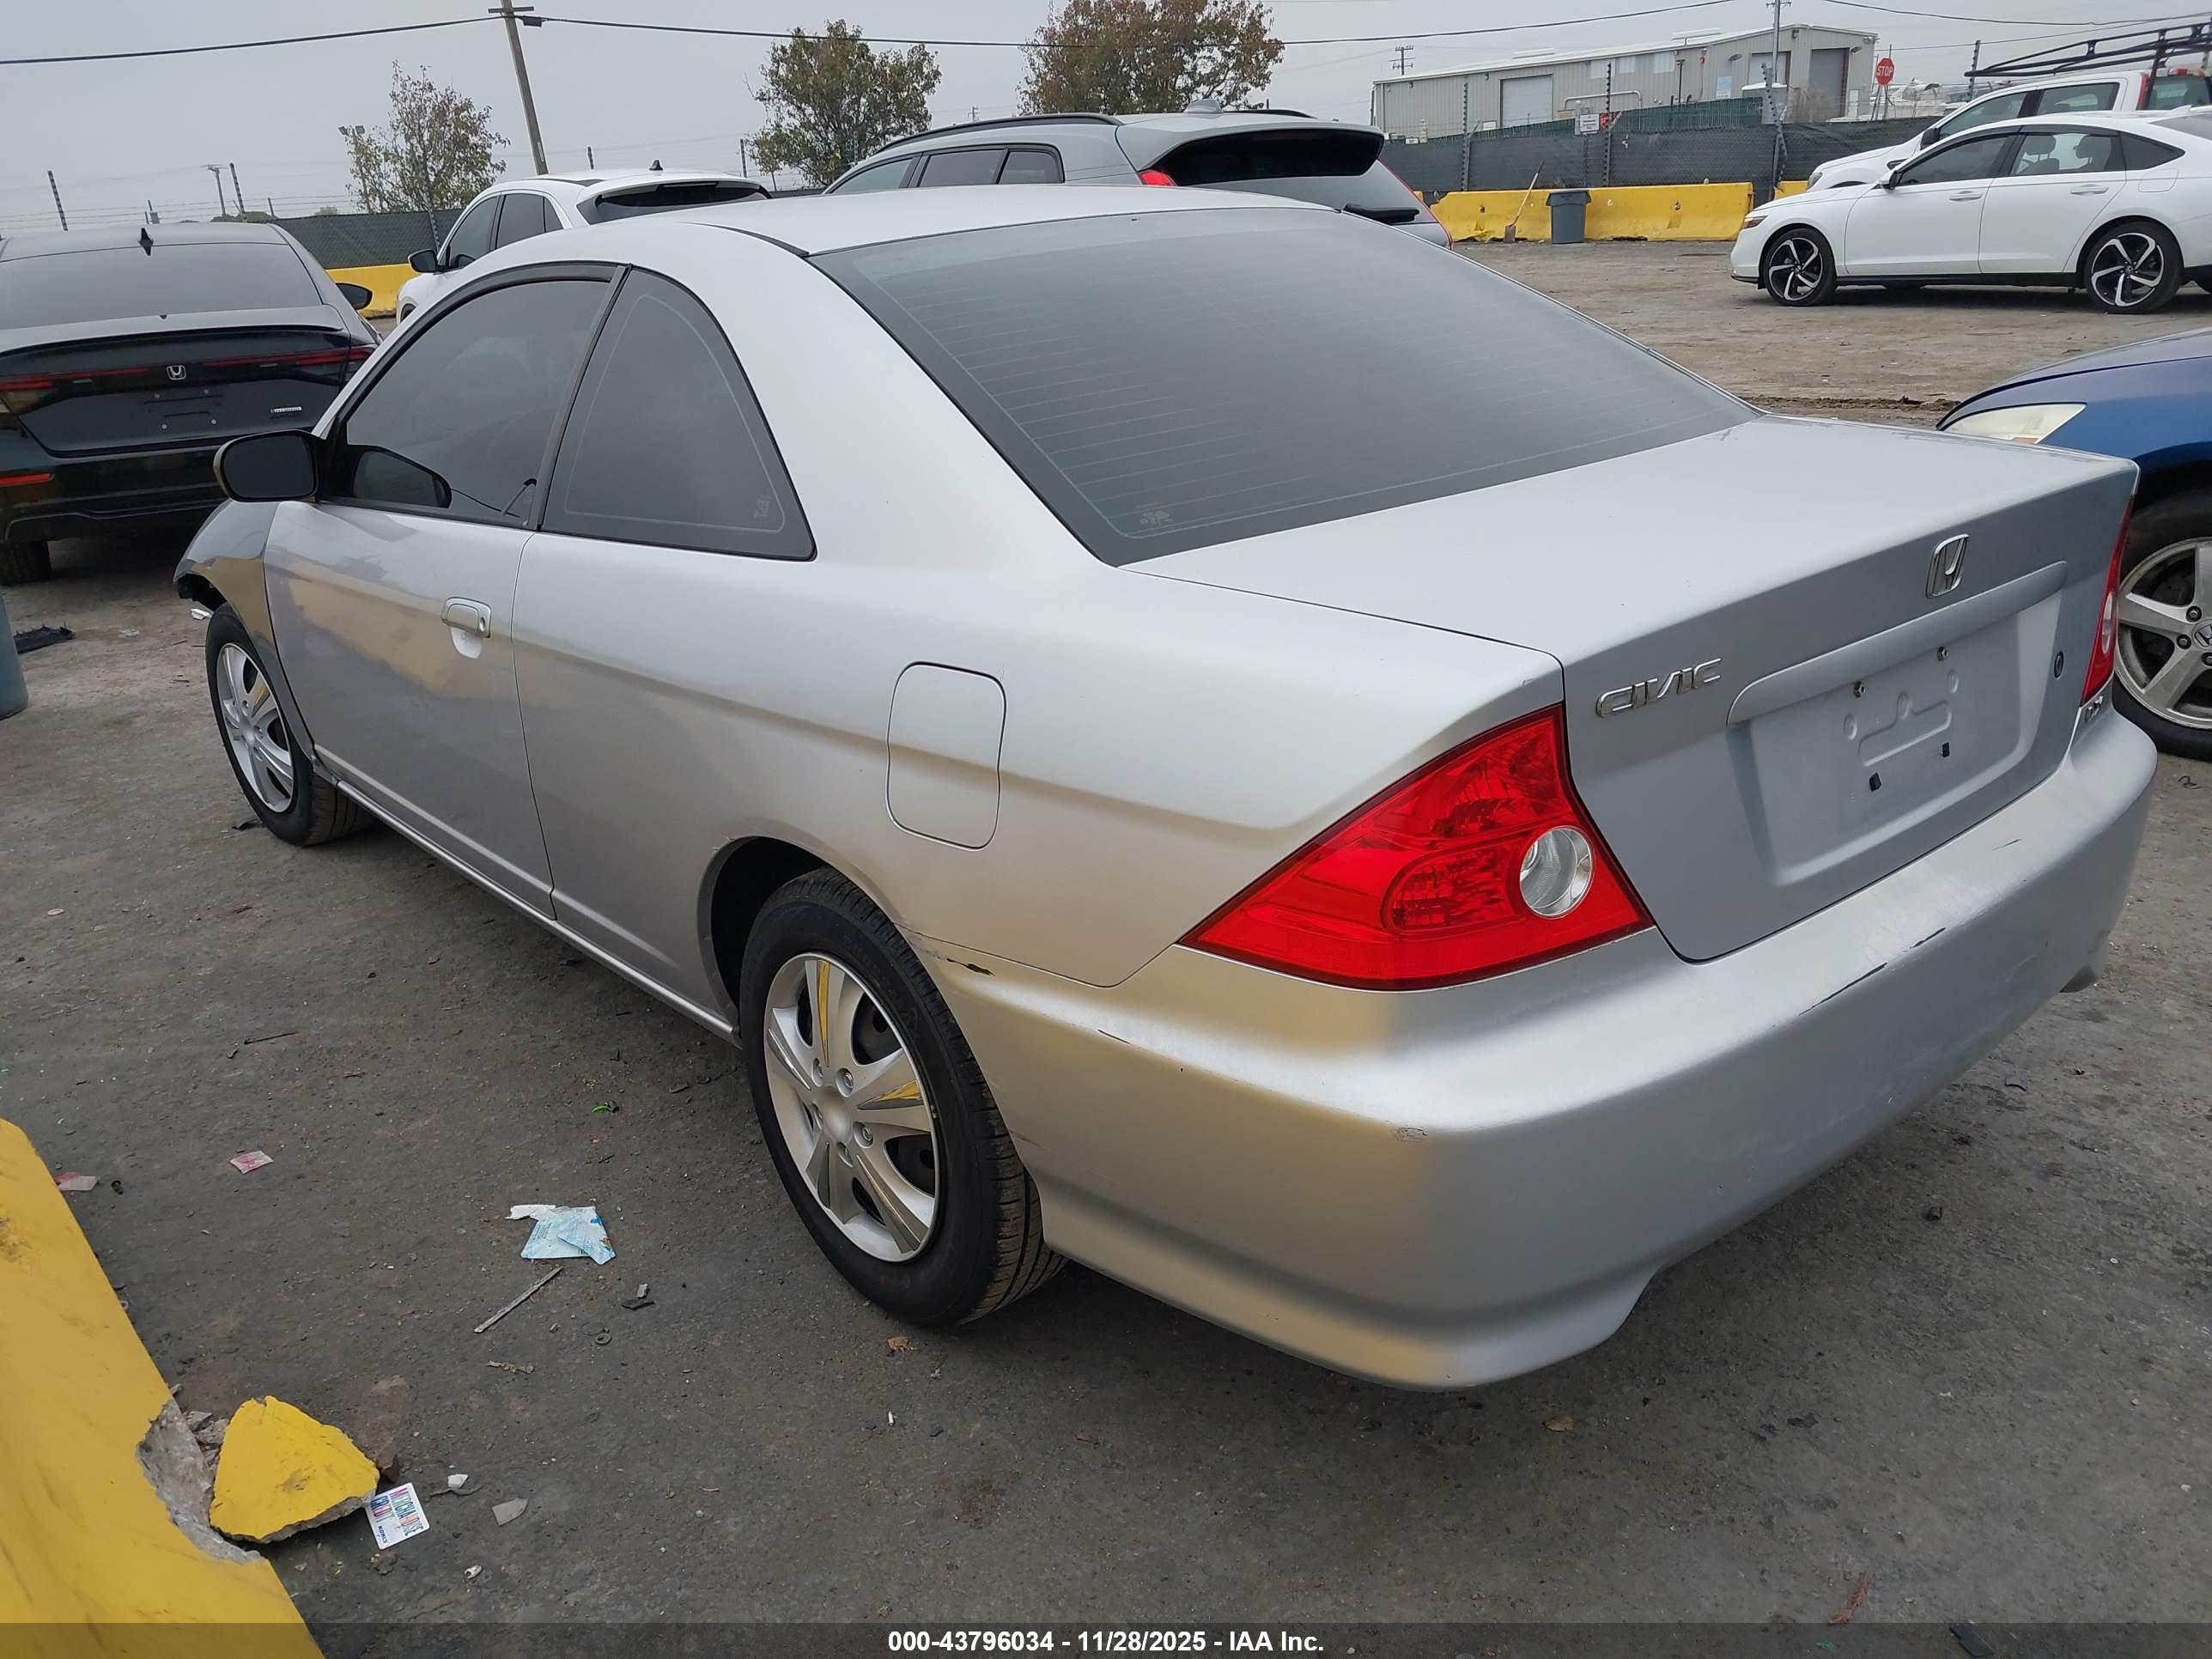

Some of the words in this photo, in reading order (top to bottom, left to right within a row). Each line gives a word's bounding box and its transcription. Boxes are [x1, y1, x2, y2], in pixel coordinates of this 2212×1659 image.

[1876, 65, 1893, 76] STOP
[1595, 658, 1723, 717] CIVIC
[370, 1495, 395, 1523] CREDIT
[389, 1487, 423, 1536] MERCHANDISE
